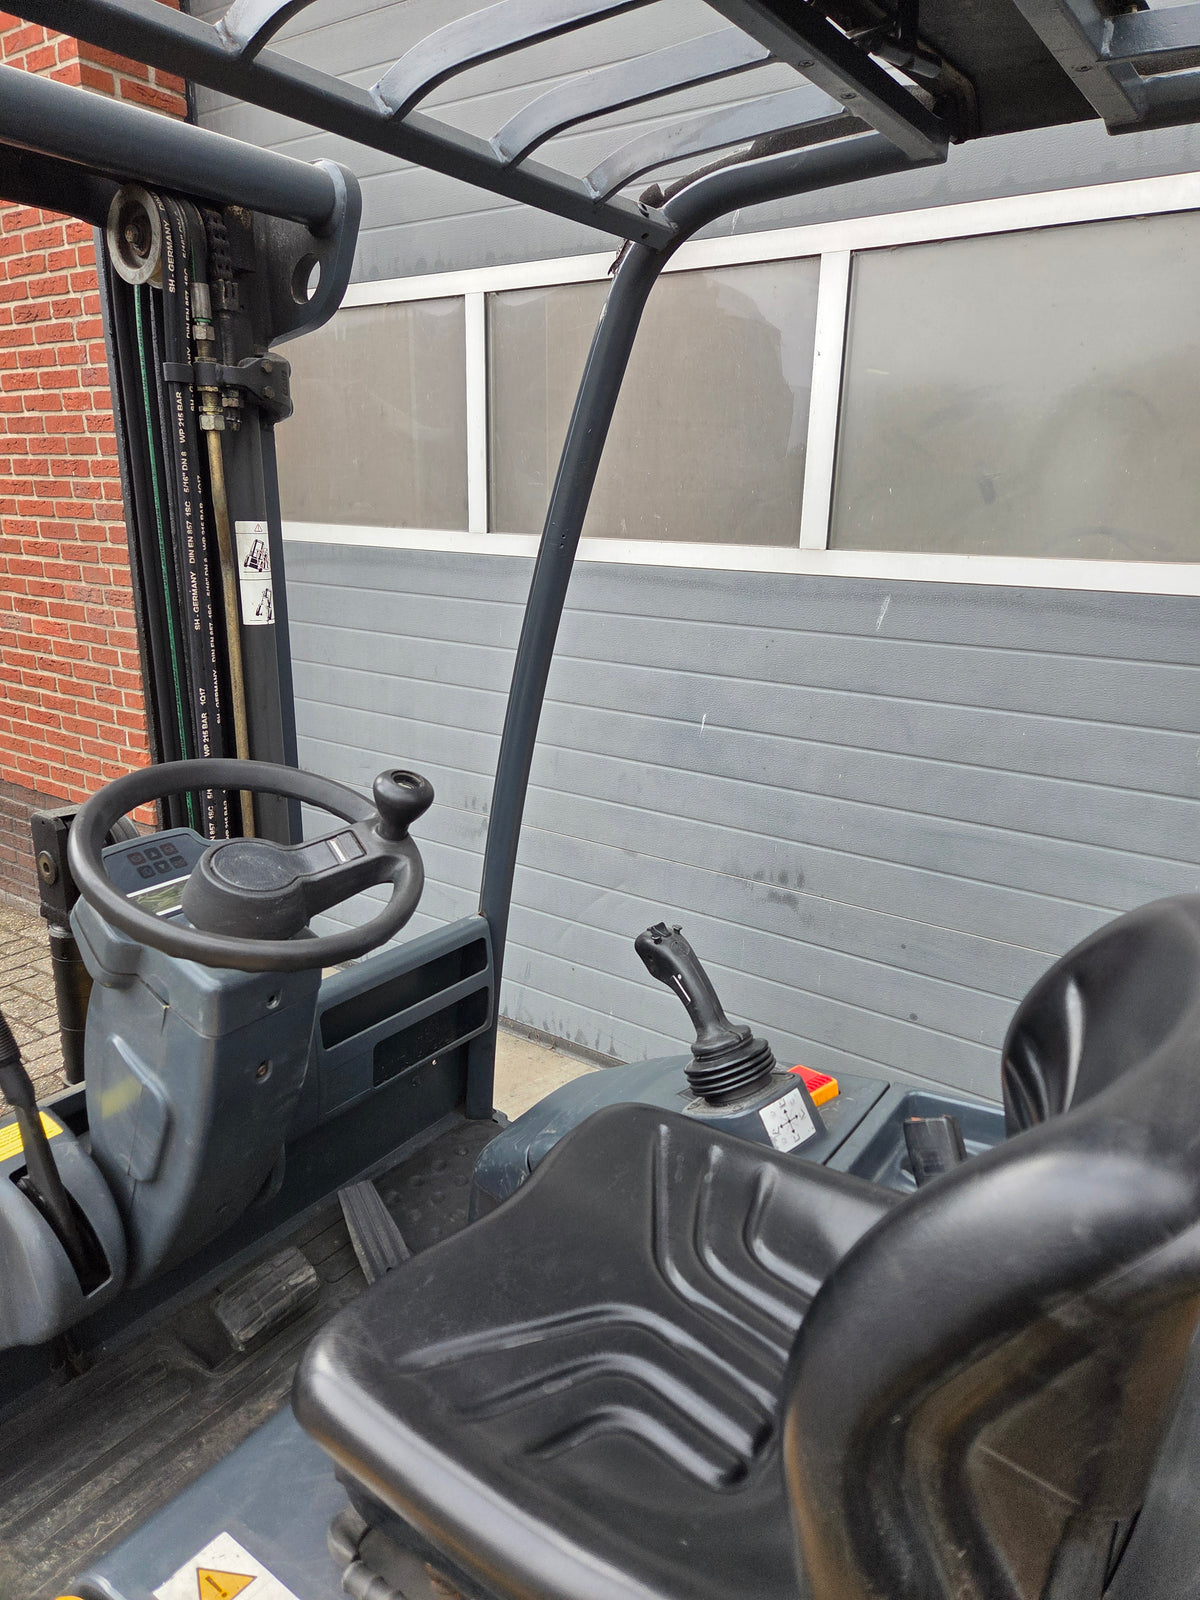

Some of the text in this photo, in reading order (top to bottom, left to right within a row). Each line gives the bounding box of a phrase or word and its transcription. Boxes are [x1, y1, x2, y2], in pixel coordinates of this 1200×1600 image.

[163, 220, 175, 272] GERMANY
[168, 279, 176, 293] SH
[179, 429, 186, 444] WP
[182, 458, 188, 471] DN
[187, 536, 194, 548] EN
[190, 571, 200, 613] GERMANY
[194, 618, 201, 631] SH
[201, 712, 209, 728] BAR
[203, 744, 210, 757] WP
